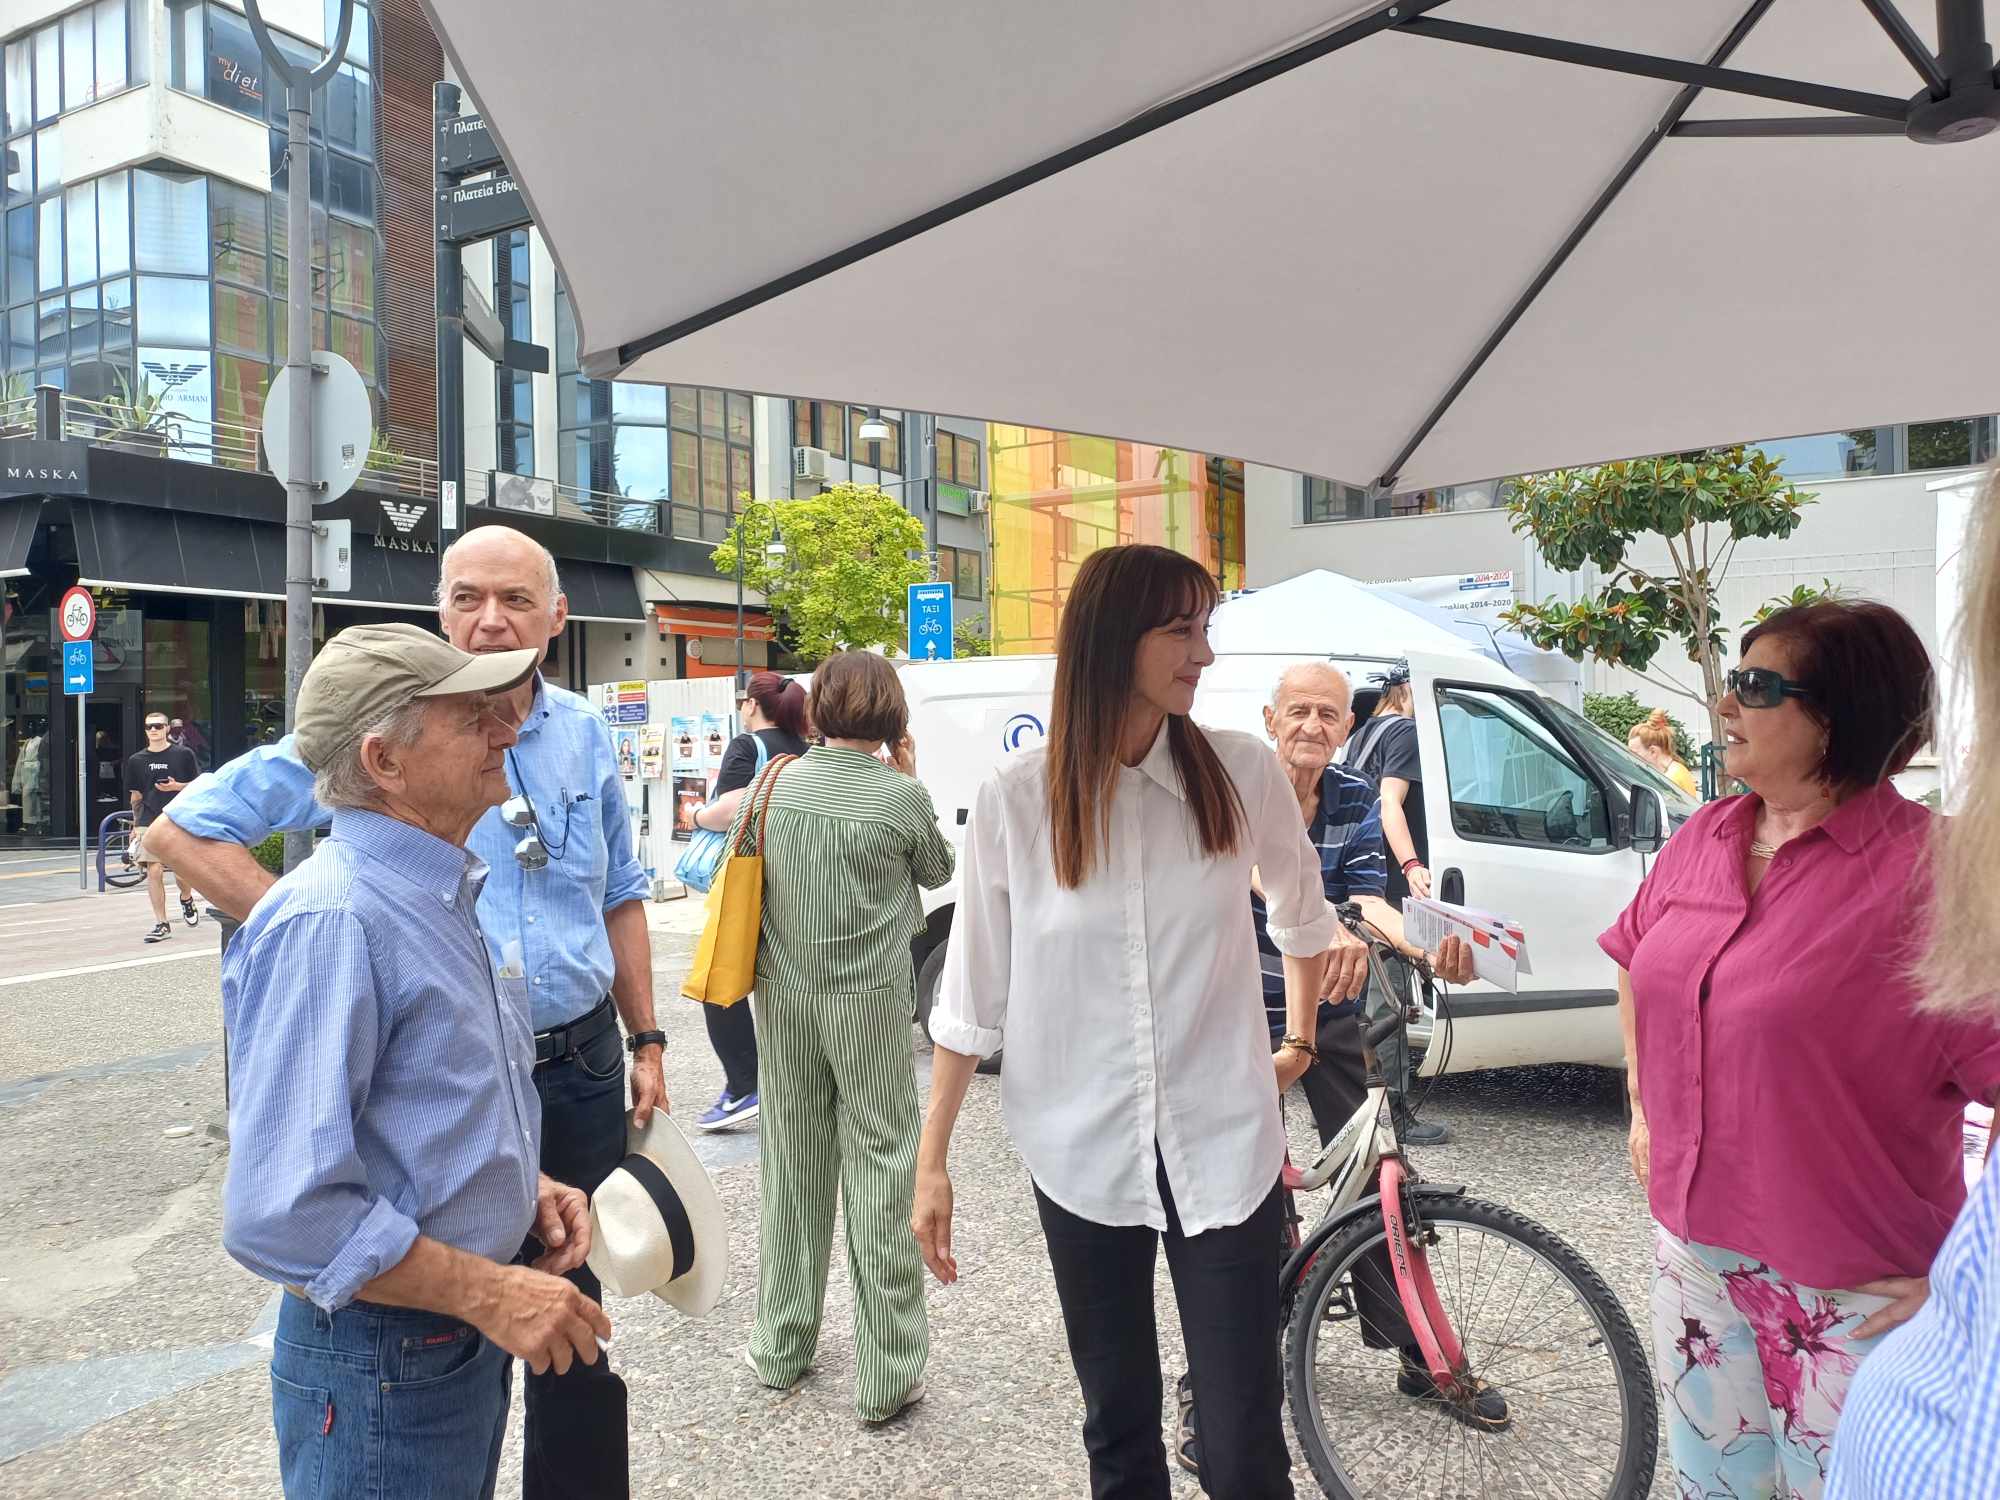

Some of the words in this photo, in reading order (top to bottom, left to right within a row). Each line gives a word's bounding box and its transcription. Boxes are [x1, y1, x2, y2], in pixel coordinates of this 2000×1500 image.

[223, 62, 258, 91] diet
[453, 186, 494, 203] Πλατεία
[178, 394, 208, 403] ARMANI
[7, 467, 78, 480] MASKA
[373, 535, 435, 554] MASKA
[922, 605, 940, 614] ΤΑΞΙ
